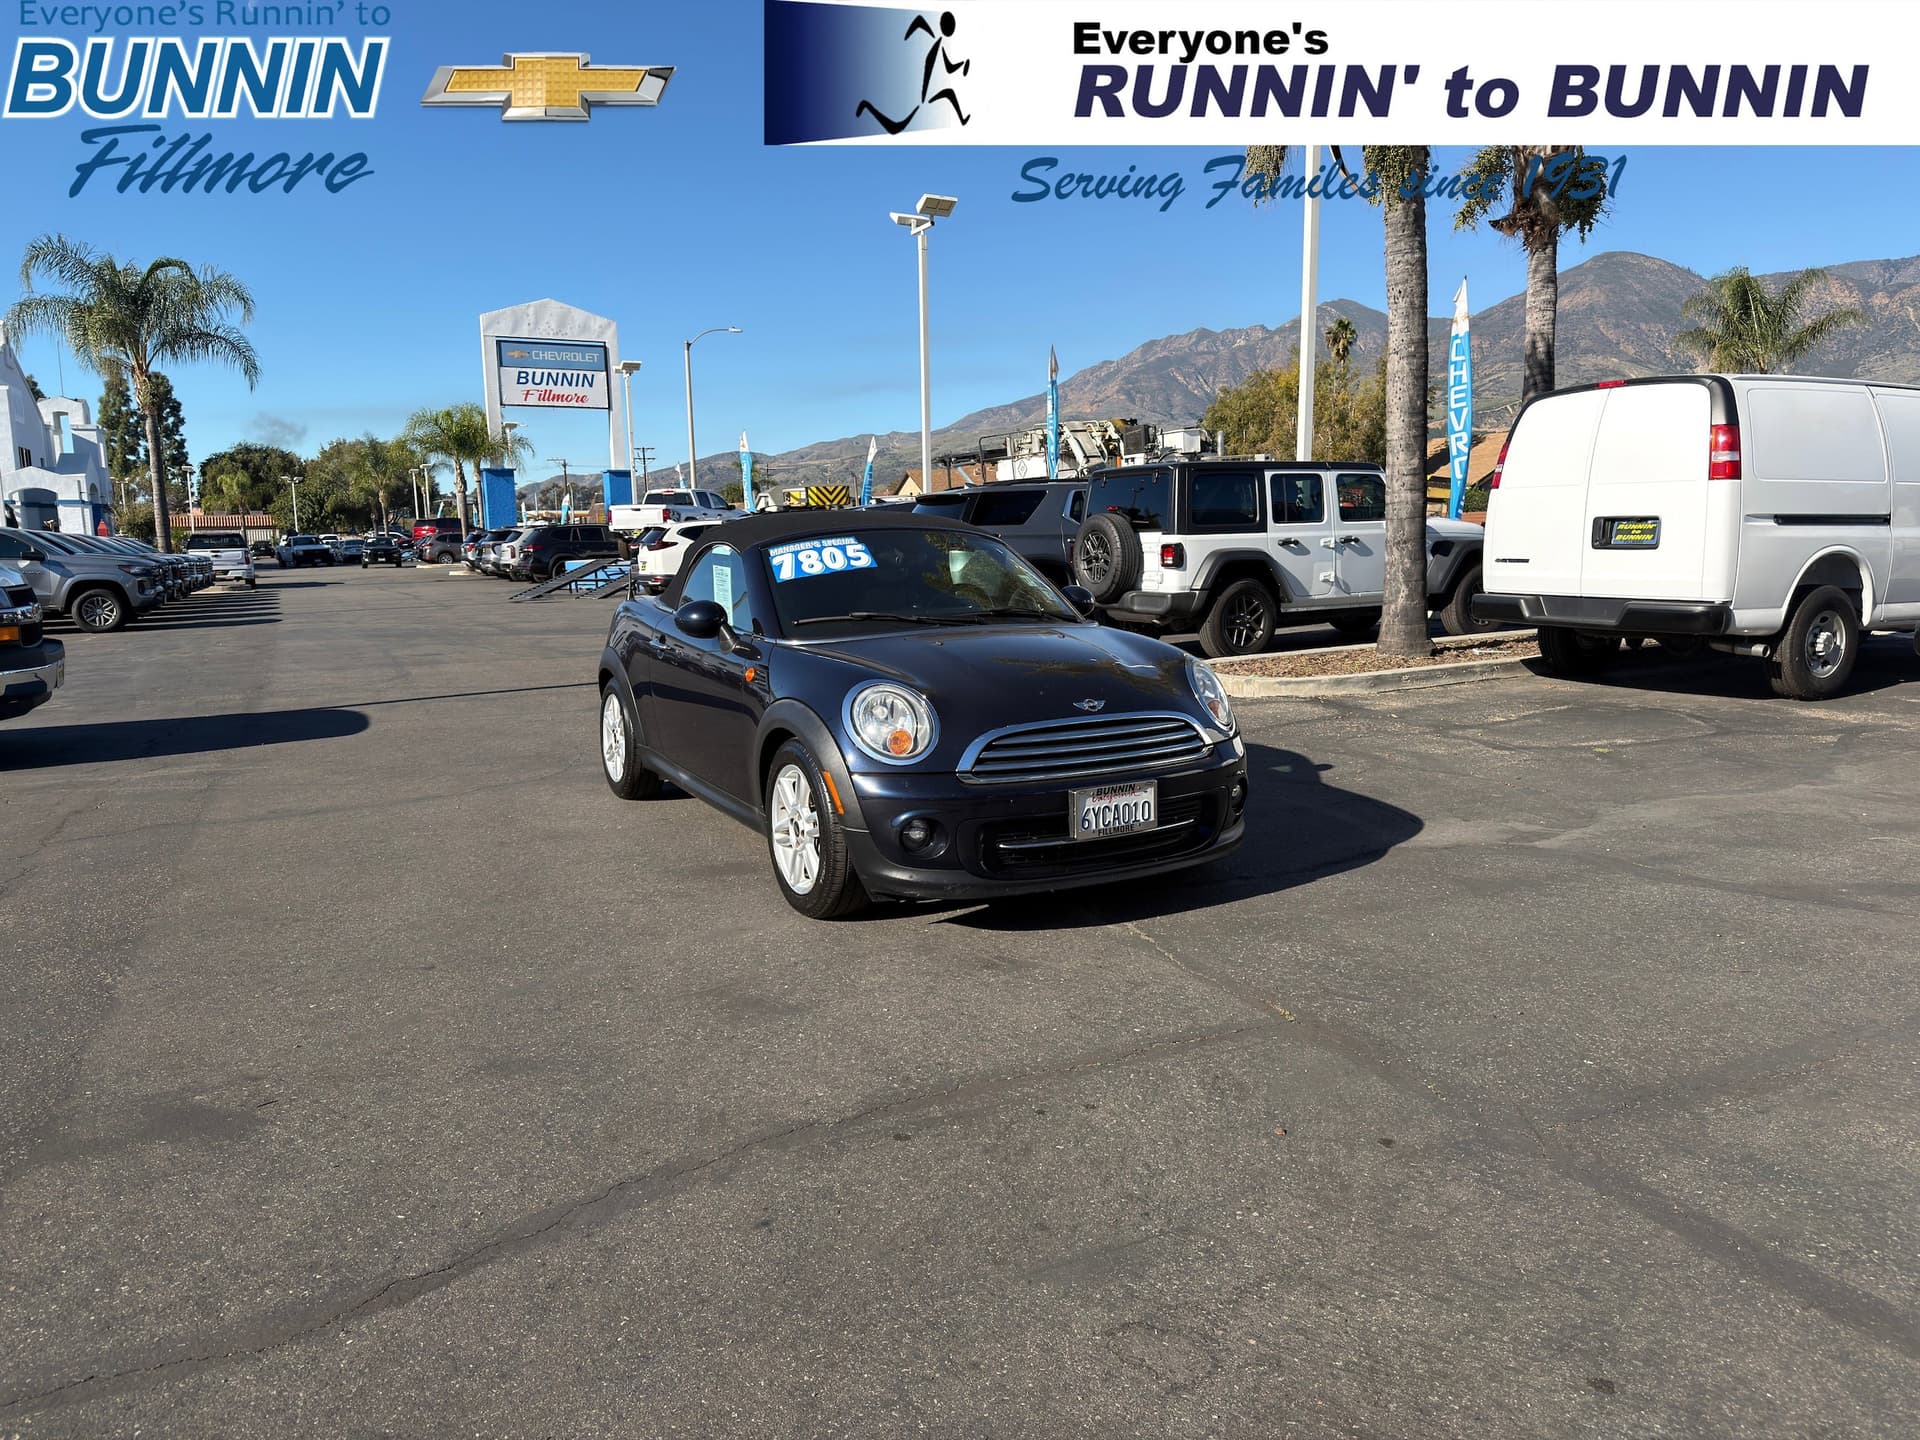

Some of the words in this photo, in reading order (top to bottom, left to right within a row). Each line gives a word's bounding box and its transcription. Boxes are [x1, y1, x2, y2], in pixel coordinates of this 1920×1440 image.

[531, 350, 600, 363] CHEVROLET
[516, 371, 595, 388] BUNNIN
[522, 389, 589, 404] Fillmore
[772, 544, 872, 580] 7805
[1095, 783, 1136, 796] BUNNIN
[1081, 800, 1151, 831] 6YCA010
[1097, 823, 1136, 836] FILLMORE
